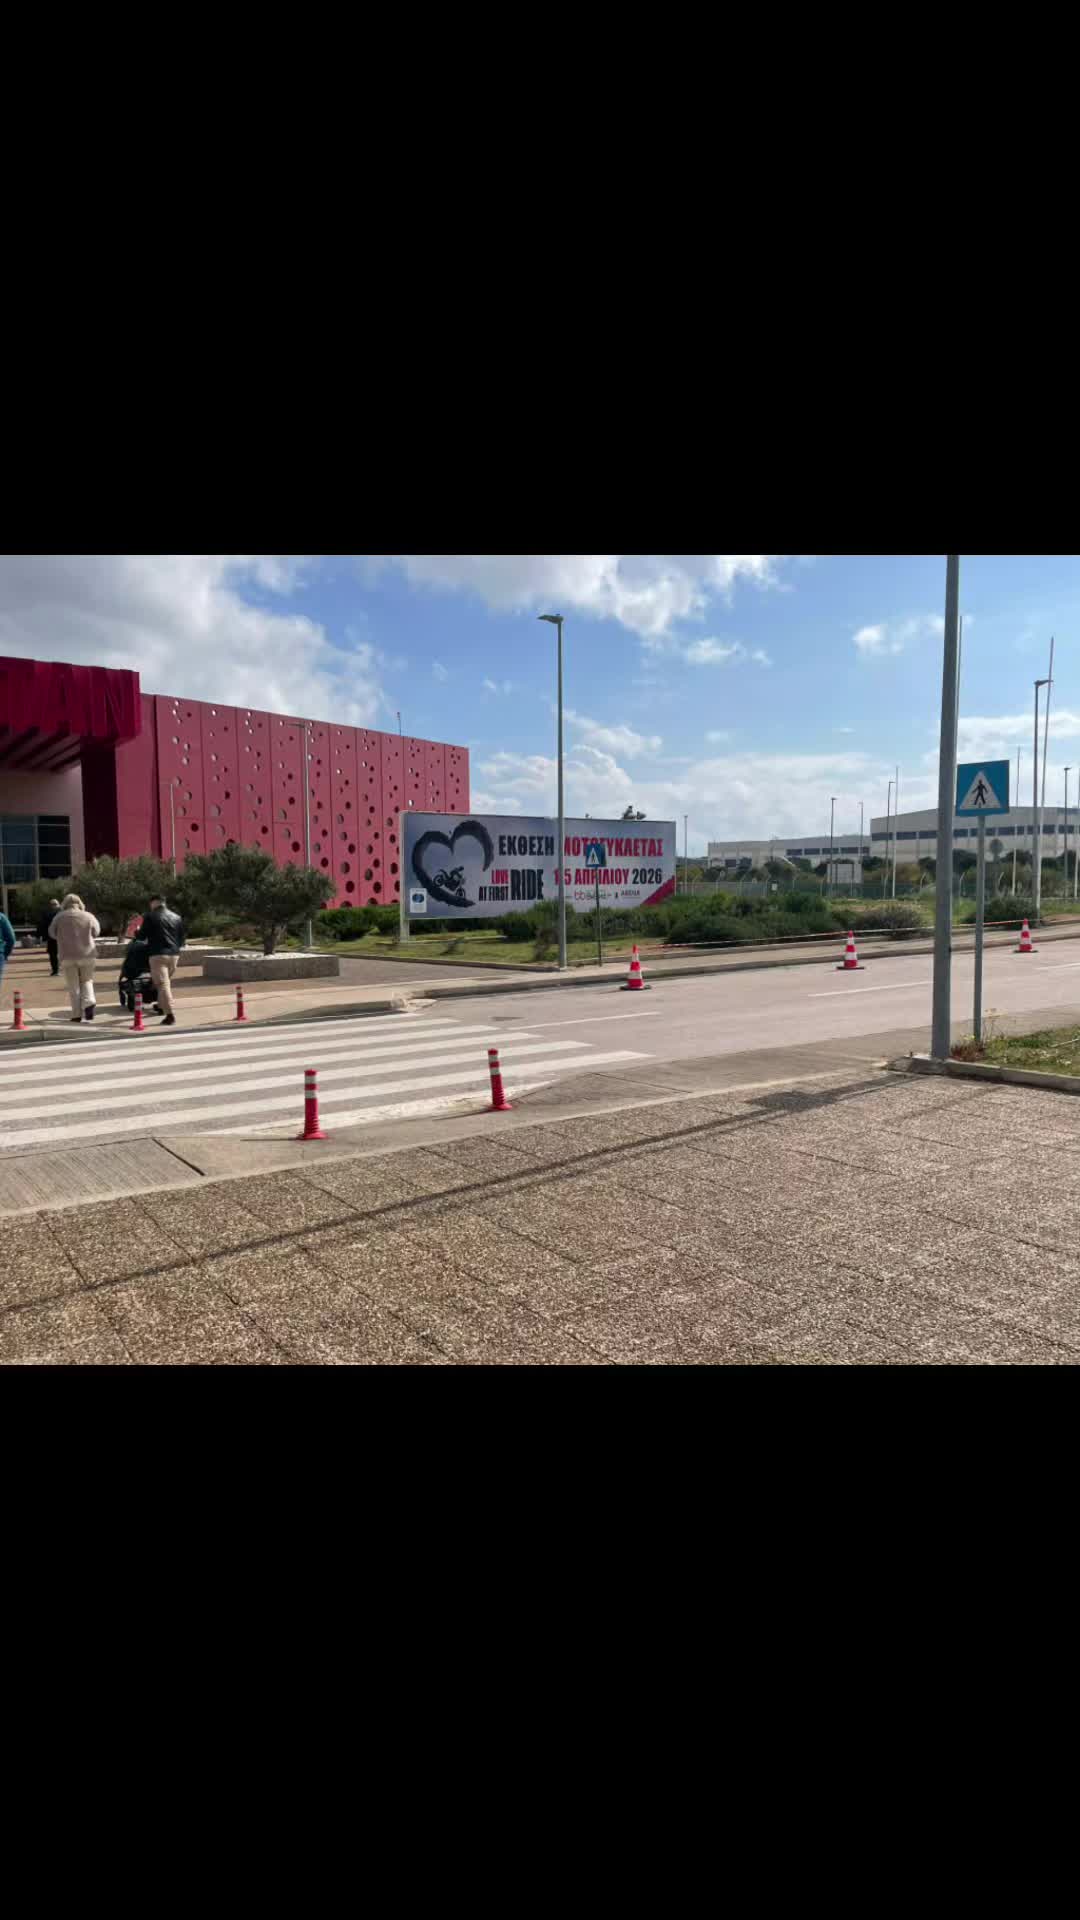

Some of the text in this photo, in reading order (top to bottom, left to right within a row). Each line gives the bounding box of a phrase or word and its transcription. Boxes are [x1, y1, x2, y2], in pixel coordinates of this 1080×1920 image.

[499, 835, 555, 857] ΕΚΘΕΣΗ
[491, 869, 509, 885] LOVE
[510, 868, 544, 901] RIDE
[632, 868, 663, 885] 2026
[488, 886, 510, 901] FIRST
